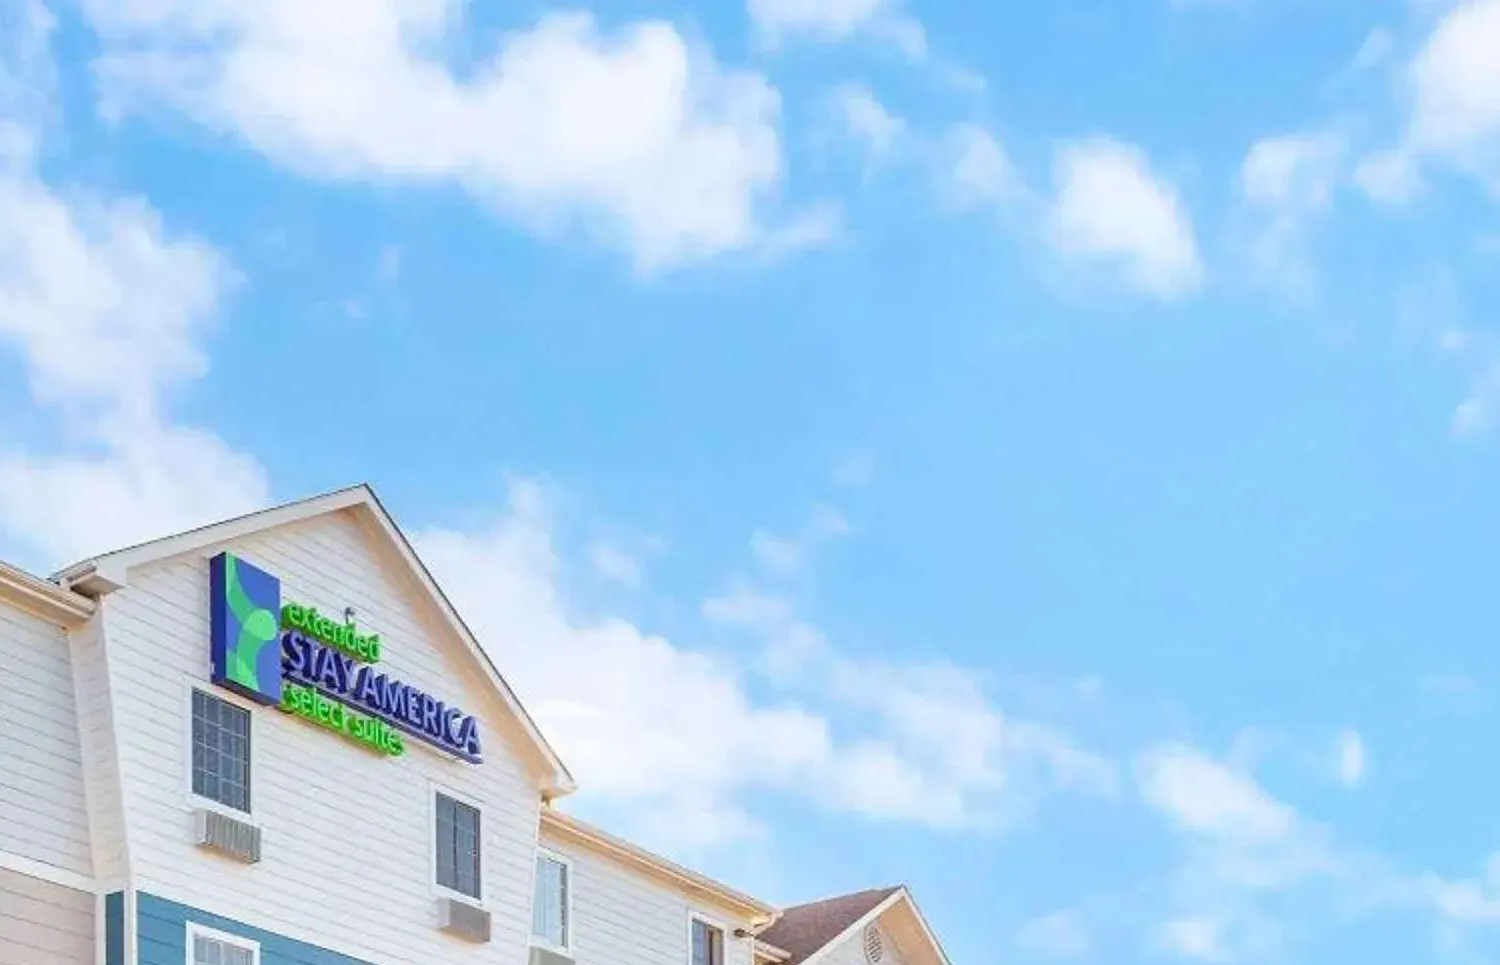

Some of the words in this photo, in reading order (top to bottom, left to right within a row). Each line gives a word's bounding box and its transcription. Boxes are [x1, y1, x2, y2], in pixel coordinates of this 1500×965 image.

[283, 604, 381, 662] extended
[282, 630, 357, 693] STAY
[355, 666, 482, 755] AMERICA
[284, 683, 349, 732] select
[352, 717, 405, 757] suites
